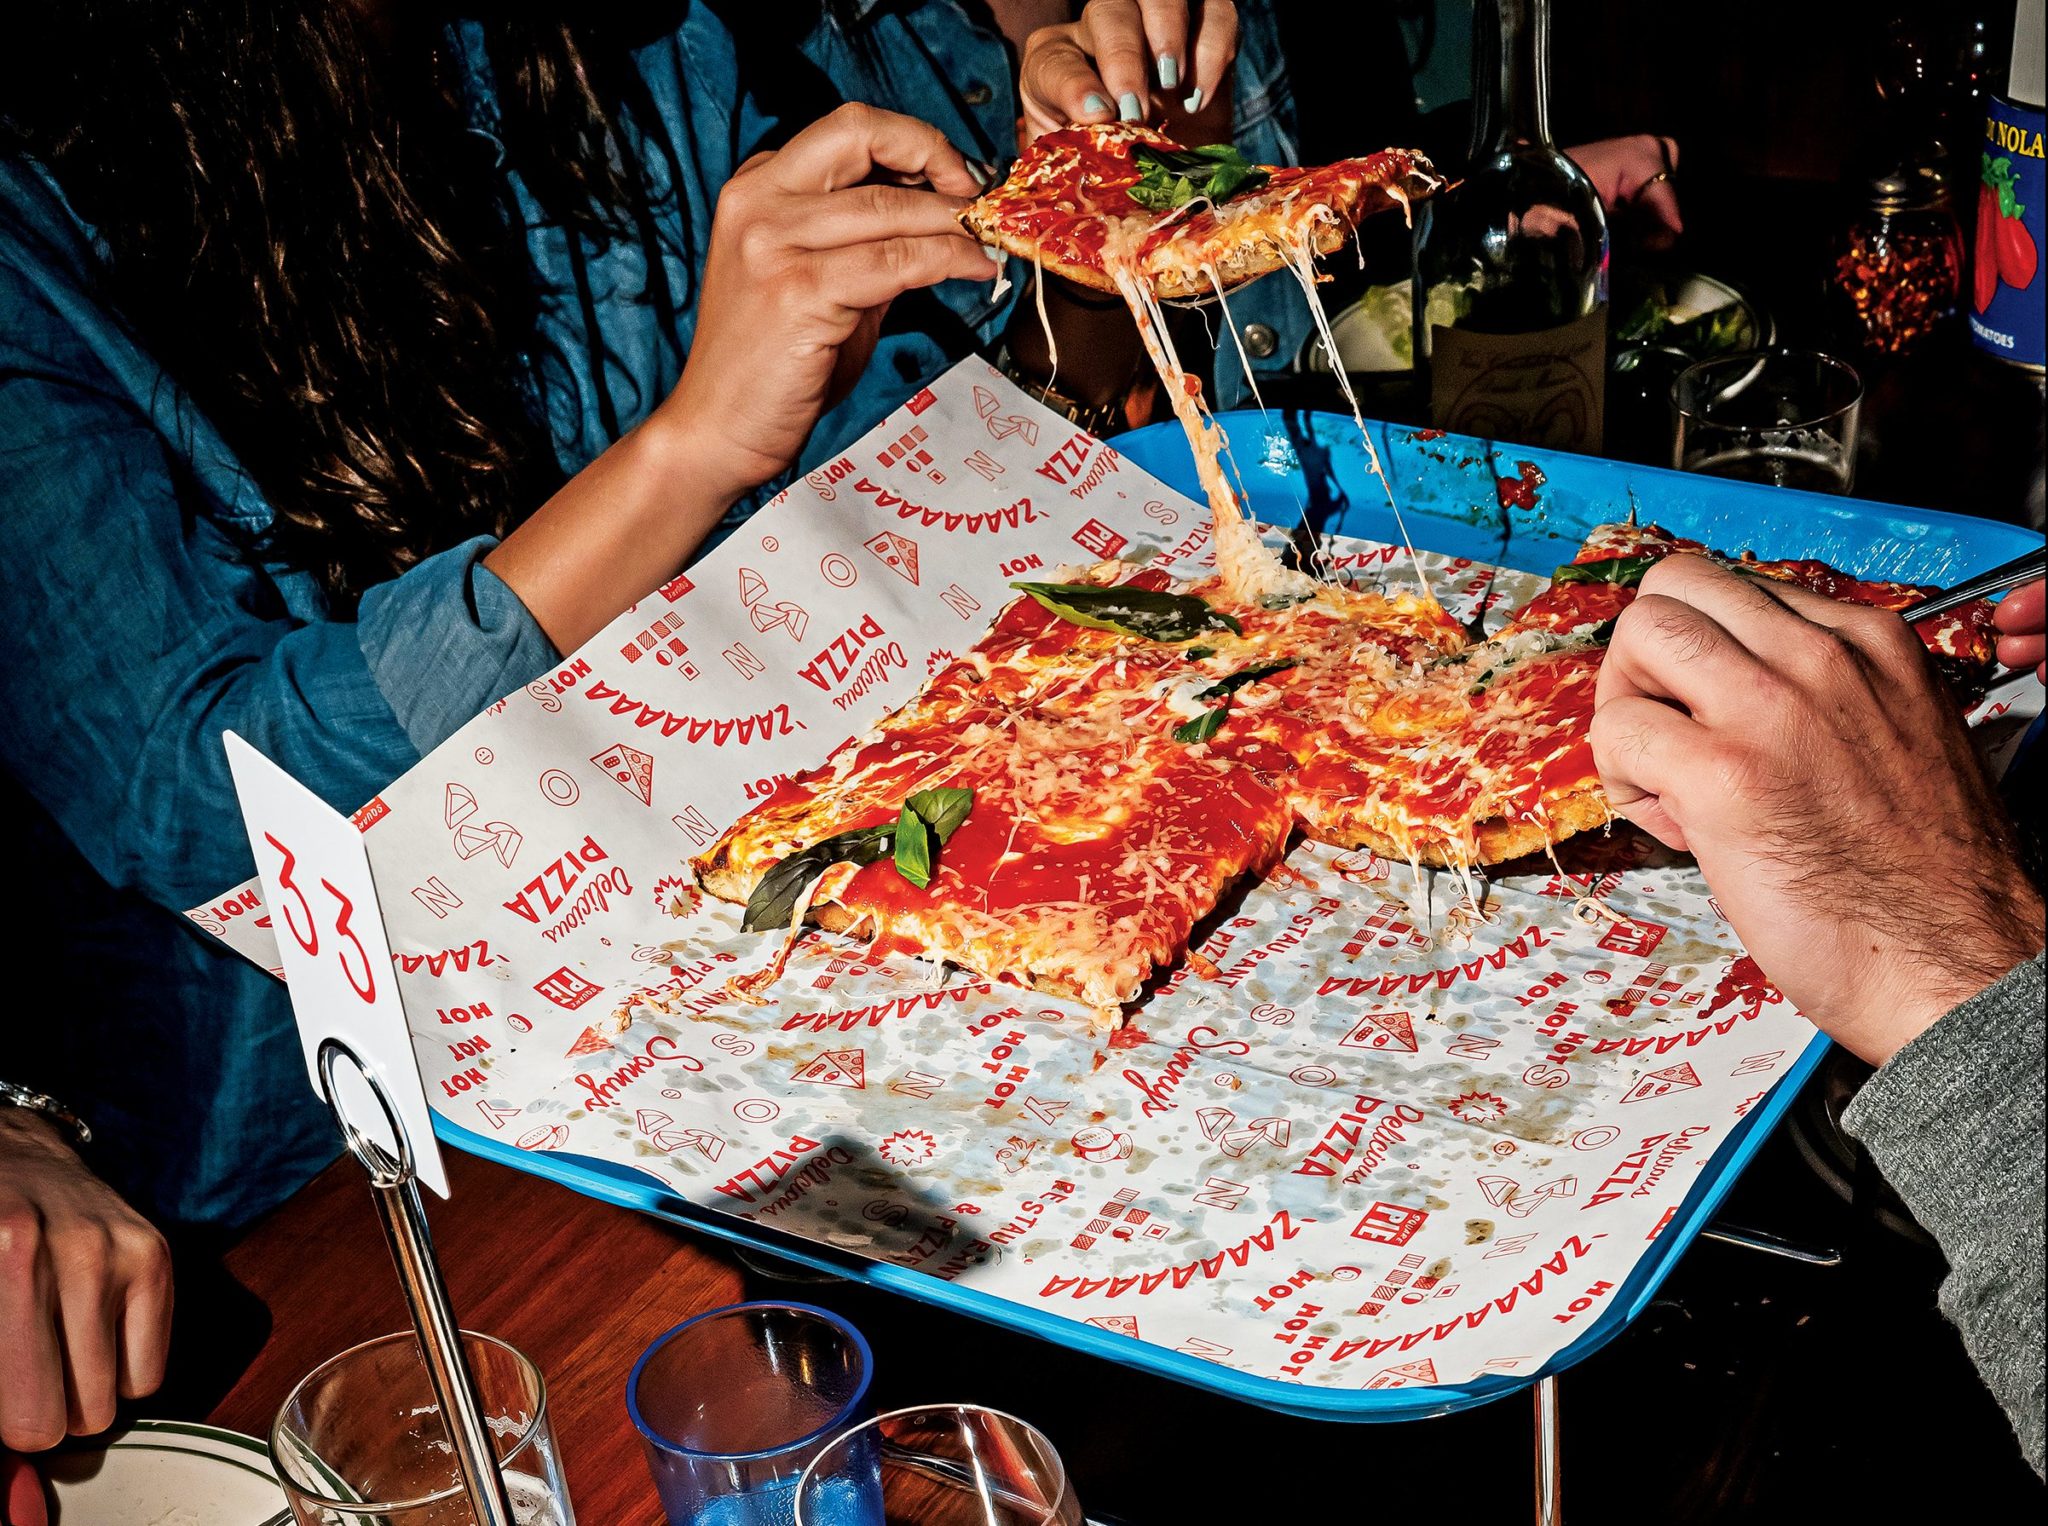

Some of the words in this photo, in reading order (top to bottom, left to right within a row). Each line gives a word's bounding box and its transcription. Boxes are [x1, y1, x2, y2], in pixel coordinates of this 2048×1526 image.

[1996, 121, 2046, 159] NOLA
[820, 457, 855, 489] HOT
[1034, 432, 1098, 486] IZZA
[1075, 520, 1115, 555] PIE
[1150, 521, 1214, 568] PIZZERI
[999, 553, 1043, 577] HOT
[1442, 557, 1473, 576] OT
[797, 613, 885, 692] PIZZA
[547, 657, 592, 694] HOT
[832, 641, 908, 711] Delicious
[742, 773, 789, 800] HOT
[502, 835, 609, 924] PIZZA
[210, 889, 262, 922] HOT
[264, 831, 376, 1004] 33
[542, 866, 633, 944] Delicious
[1227, 917, 1257, 930] &
[1212, 896, 1341, 990] RESTAURANT
[1603, 924, 1650, 953] PIE
[542, 970, 584, 1004] PIE
[1514, 971, 1569, 1007] HOT
[436, 1001, 492, 1025] HOT
[965, 1007, 1024, 1037] HOT
[1536, 1001, 1580, 1037] HOT
[445, 1035, 492, 1062] HOT
[980, 1031, 1027, 1075] HOT
[1545, 1032, 1589, 1065] HOT
[439, 1067, 487, 1098] HOT
[573, 1036, 704, 1112] Sonny's
[983, 1065, 1032, 1109] HOT
[1291, 1095, 1386, 1177] PIZZA
[1342, 1104, 1424, 1186] Delicious
[713, 1135, 821, 1204] PIZZA
[759, 1146, 853, 1216] Delicious
[1579, 1131, 1672, 1210] PIZZA
[1631, 1125, 1710, 1199] Delicious
[952, 1202, 982, 1216] &
[1355, 1203, 1402, 1240] PIE
[1396, 1214, 1421, 1243] SQUARE
[899, 1215, 958, 1267] PIZZE
[1252, 1270, 1315, 1312] HOT
[1552, 1281, 1615, 1324] HOT
[1273, 1303, 1324, 1345] HOT
[1279, 1335, 1331, 1377] HOT
